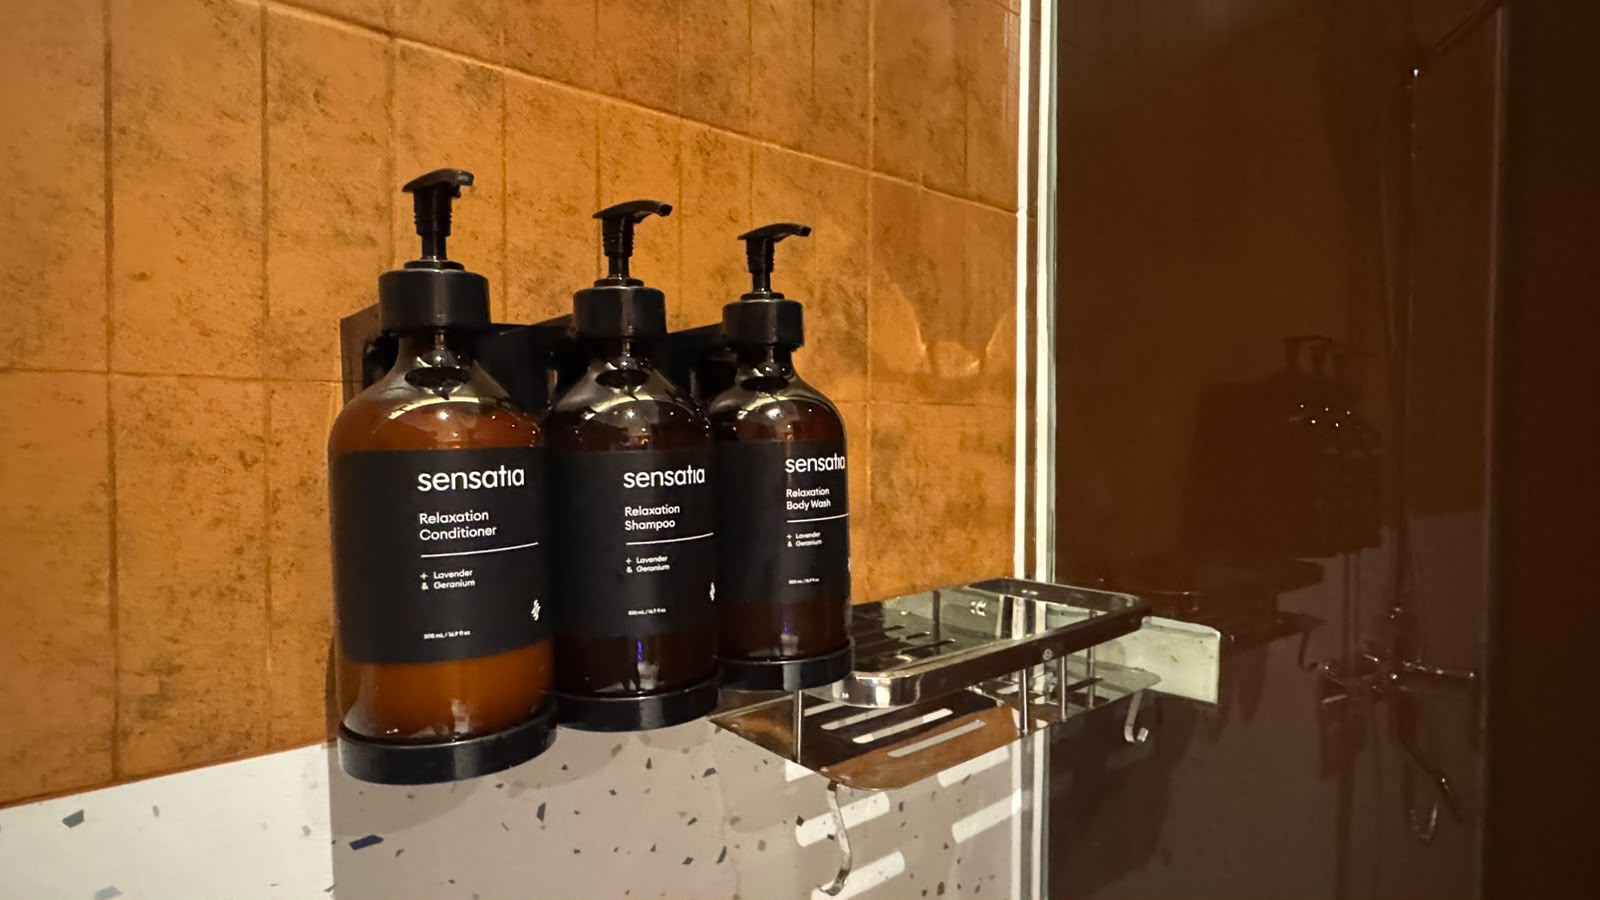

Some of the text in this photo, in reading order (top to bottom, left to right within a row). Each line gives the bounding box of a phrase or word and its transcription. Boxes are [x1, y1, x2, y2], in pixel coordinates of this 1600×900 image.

[784, 452, 846, 473] sensatia
[417, 464, 525, 492] sensatia
[623, 464, 705, 488] sensatia
[785, 487, 830, 498] Relaxation
[624, 504, 680, 517] Relaxation
[786, 498, 832, 511] Body Wash
[419, 509, 489, 525] Relaxation
[624, 519, 676, 531] Shampoo
[419, 526, 498, 541] Conditioner
[636, 555, 668, 564] Lavender
[433, 568, 473, 580] Lavender
[636, 563, 670, 573] Geranium
[421, 579, 476, 591] & Geranium
